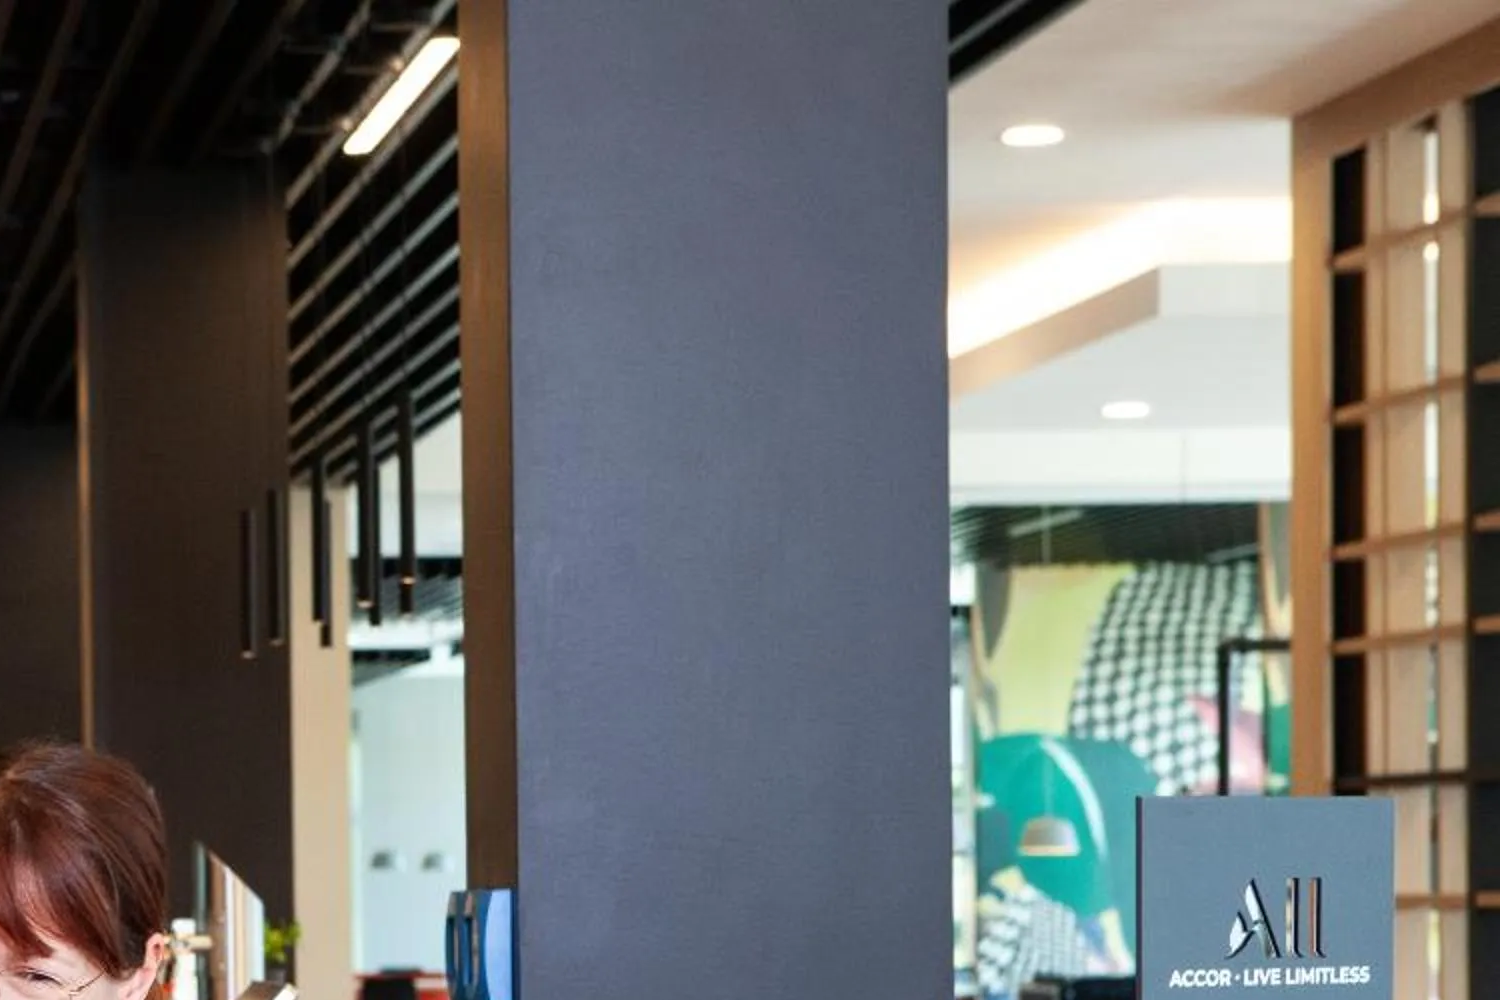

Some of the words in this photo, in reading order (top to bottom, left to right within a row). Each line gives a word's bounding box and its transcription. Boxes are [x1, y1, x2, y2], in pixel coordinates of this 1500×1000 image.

[1169, 969, 1231, 988] ACCOR
[1243, 968, 1282, 986] LIVE
[1285, 966, 1371, 985] LIMITLESS
